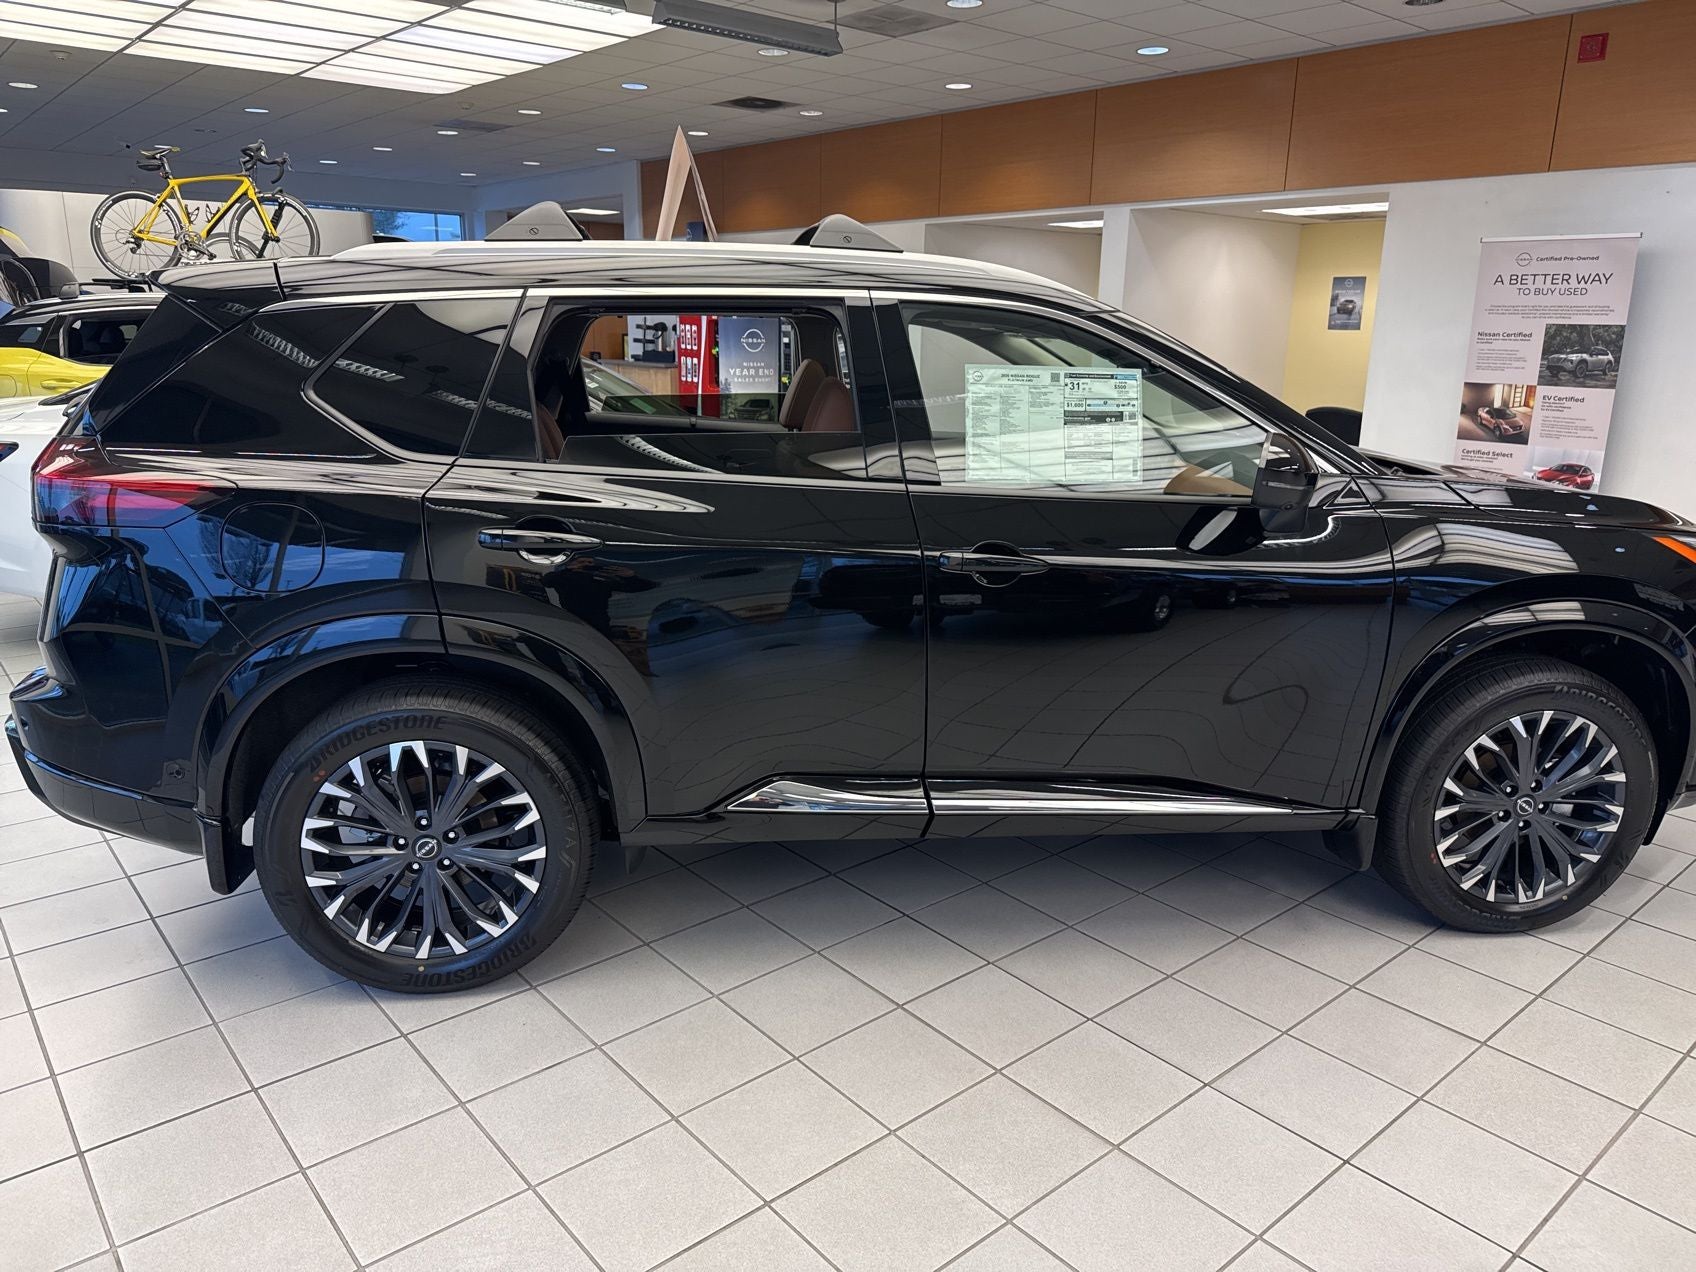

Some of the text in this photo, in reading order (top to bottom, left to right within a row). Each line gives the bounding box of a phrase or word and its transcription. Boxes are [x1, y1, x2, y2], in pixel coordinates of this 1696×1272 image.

[1493, 272, 1614, 286] A BETTER WAY
[1516, 287, 1588, 296] TO BUY USED
[728, 368, 774, 376] YEAR END
[1069, 381, 1081, 391] 31
[1552, 395, 1585, 403] Certified
[1461, 448, 1490, 457] Certified
[1491, 450, 1513, 459] Select
[307, 714, 448, 773] BRIDGESTONE
[399, 933, 537, 988] BRIDGESTONE
